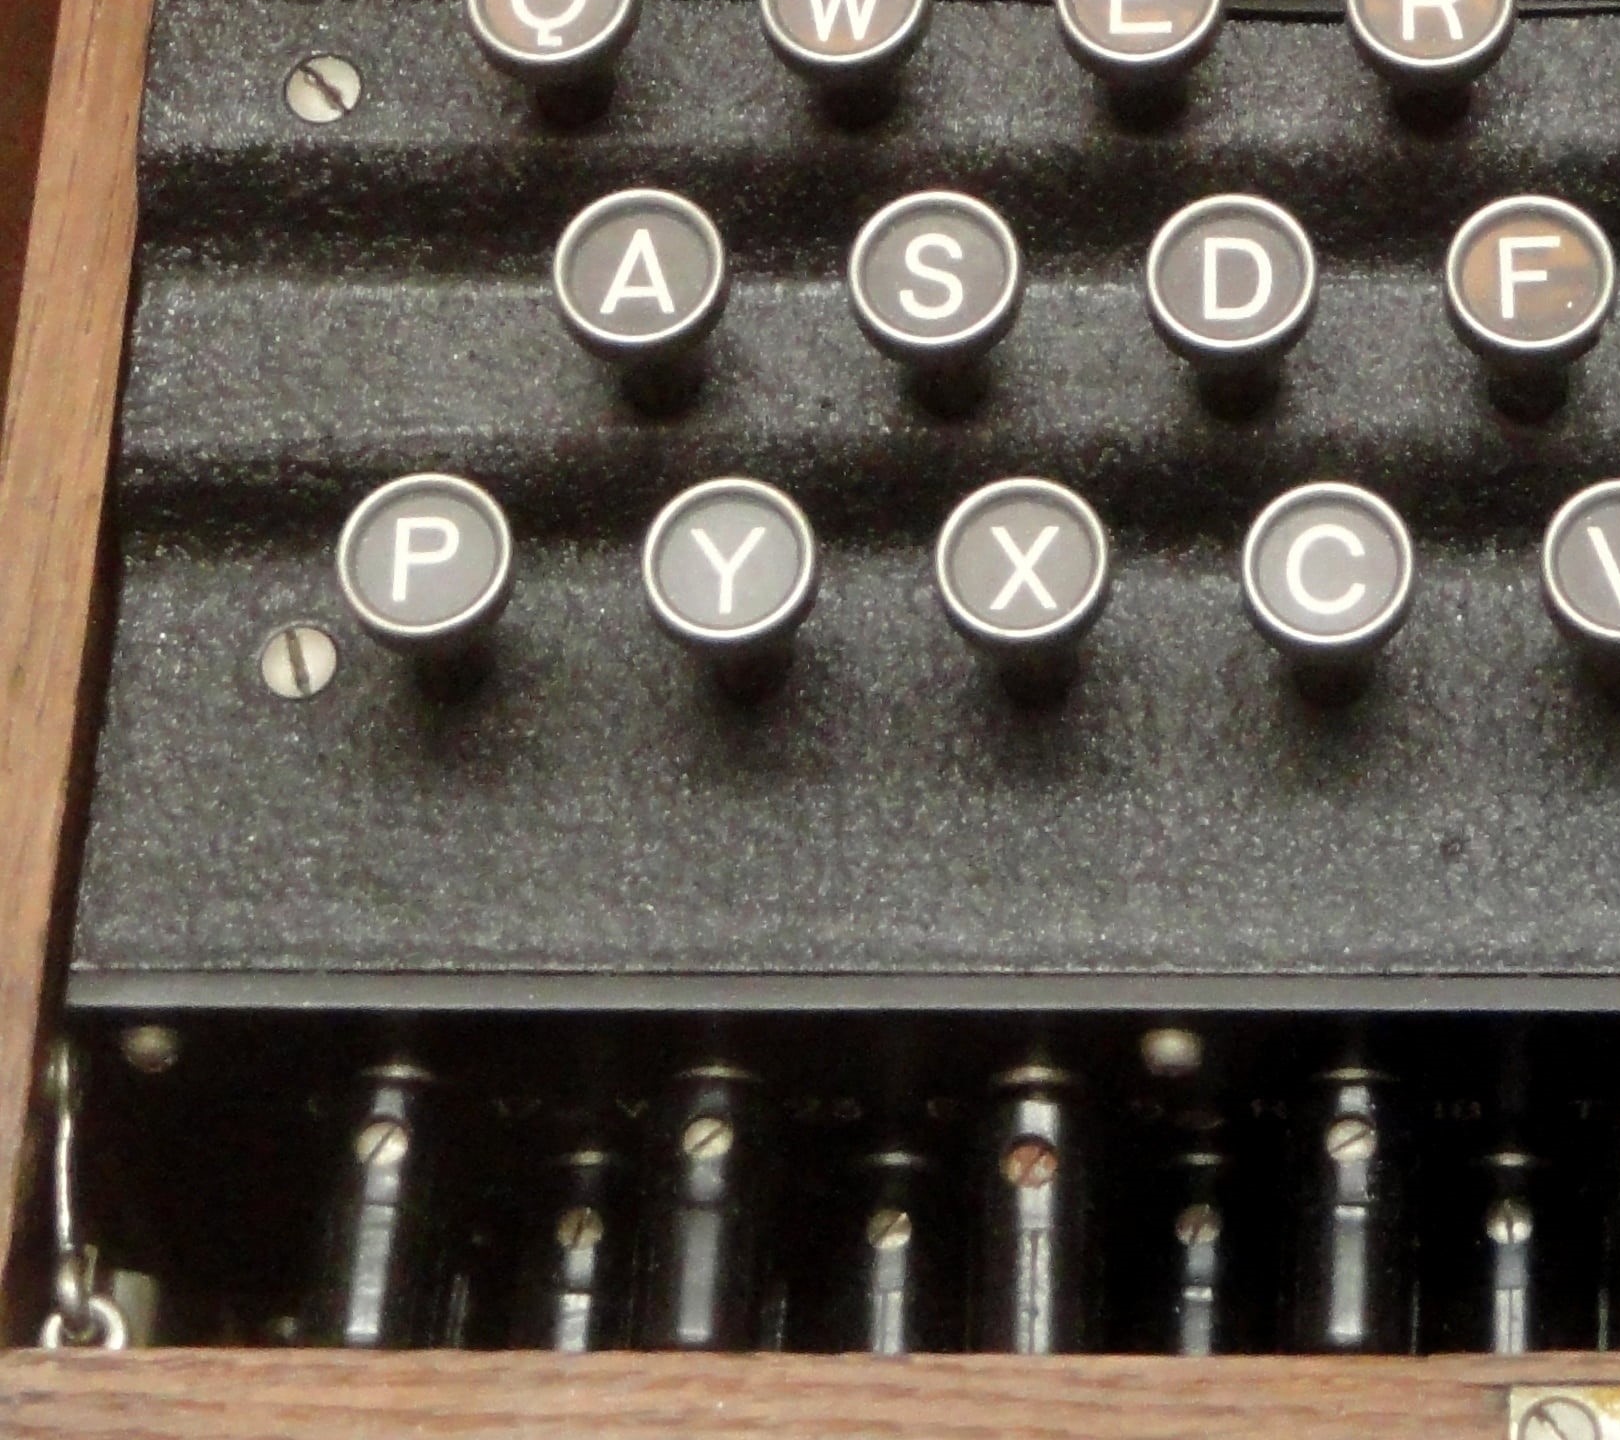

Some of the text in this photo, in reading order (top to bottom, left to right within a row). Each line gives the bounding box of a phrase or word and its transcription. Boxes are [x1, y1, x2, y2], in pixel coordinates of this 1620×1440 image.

[600, 229, 674, 314] A
[900, 233, 963, 320] S
[1203, 237, 1272, 320] D
[1499, 236, 1560, 318] F
[390, 517, 460, 602] P
[690, 526, 766, 615] Y
[990, 526, 1059, 610] X
[1285, 524, 1366, 613] C
